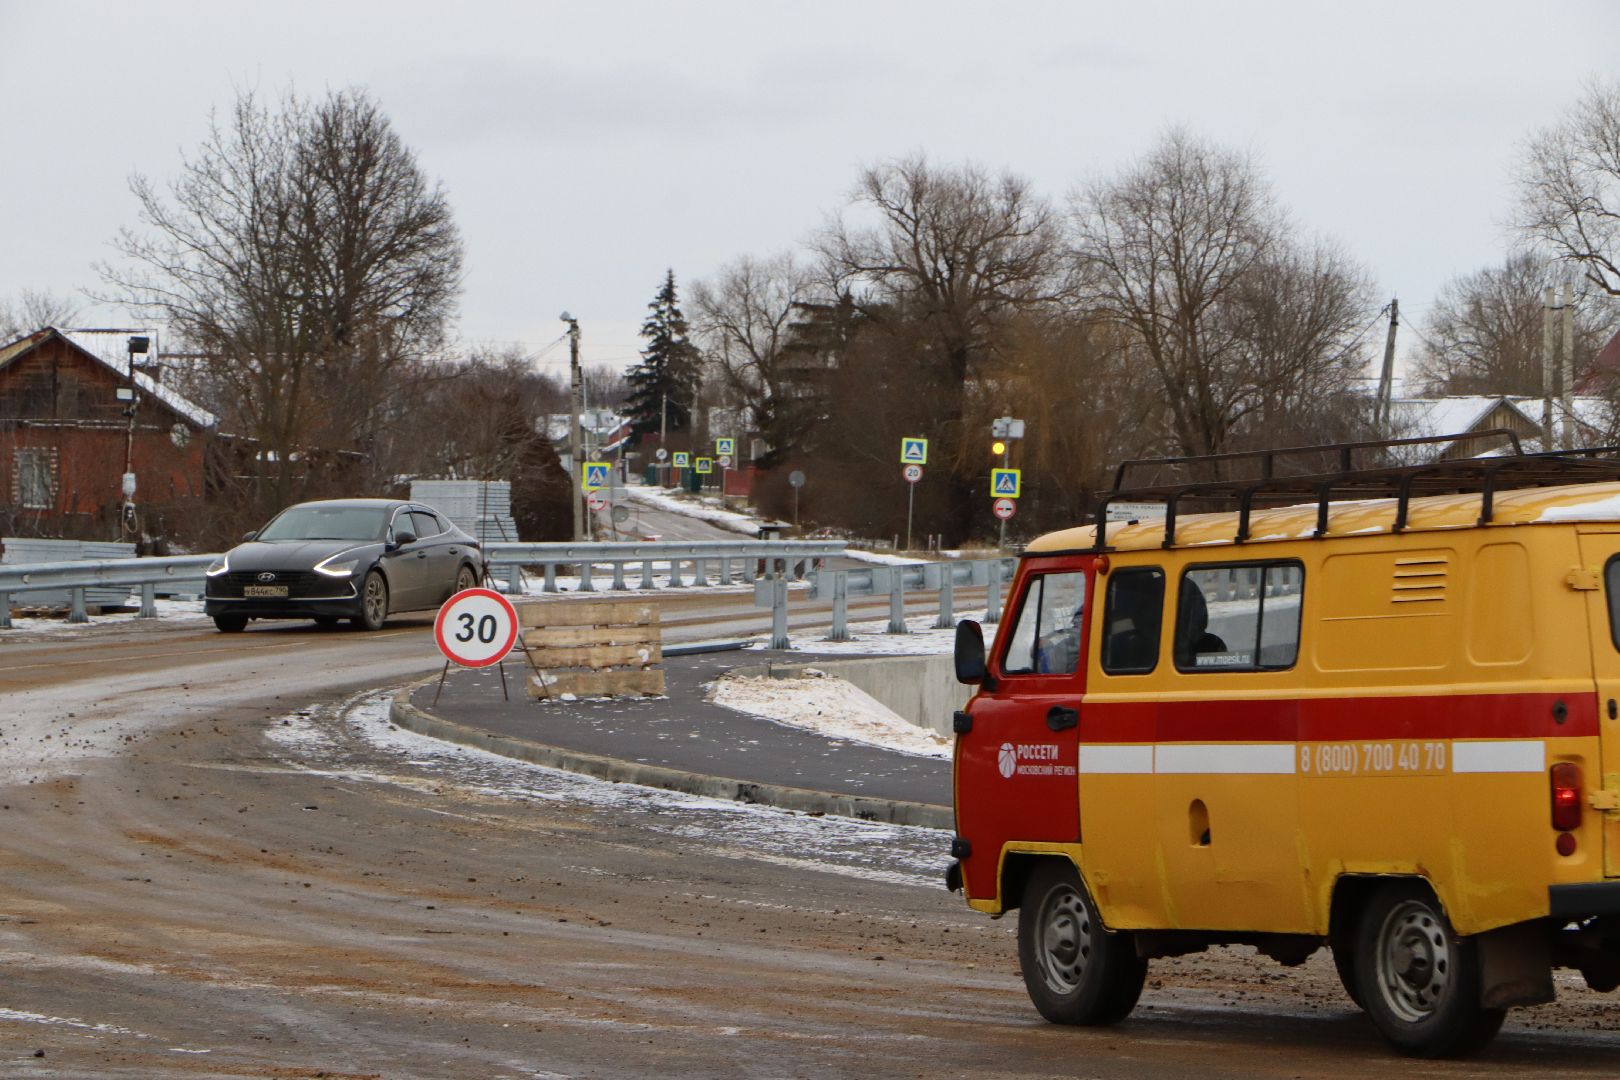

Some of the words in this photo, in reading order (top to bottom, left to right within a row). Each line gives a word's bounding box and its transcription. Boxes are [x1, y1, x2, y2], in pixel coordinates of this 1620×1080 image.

[907, 468, 919, 477] 20
[455, 612, 497, 643] 30
[1017, 744, 1059, 760] РОССЕТИ
[1300, 745, 1311, 772] 8
[1315, 743, 1359, 775] (800)
[1362, 743, 1394, 772] 700
[1397, 743, 1420, 771] 40
[1424, 742, 1446, 770] 70
